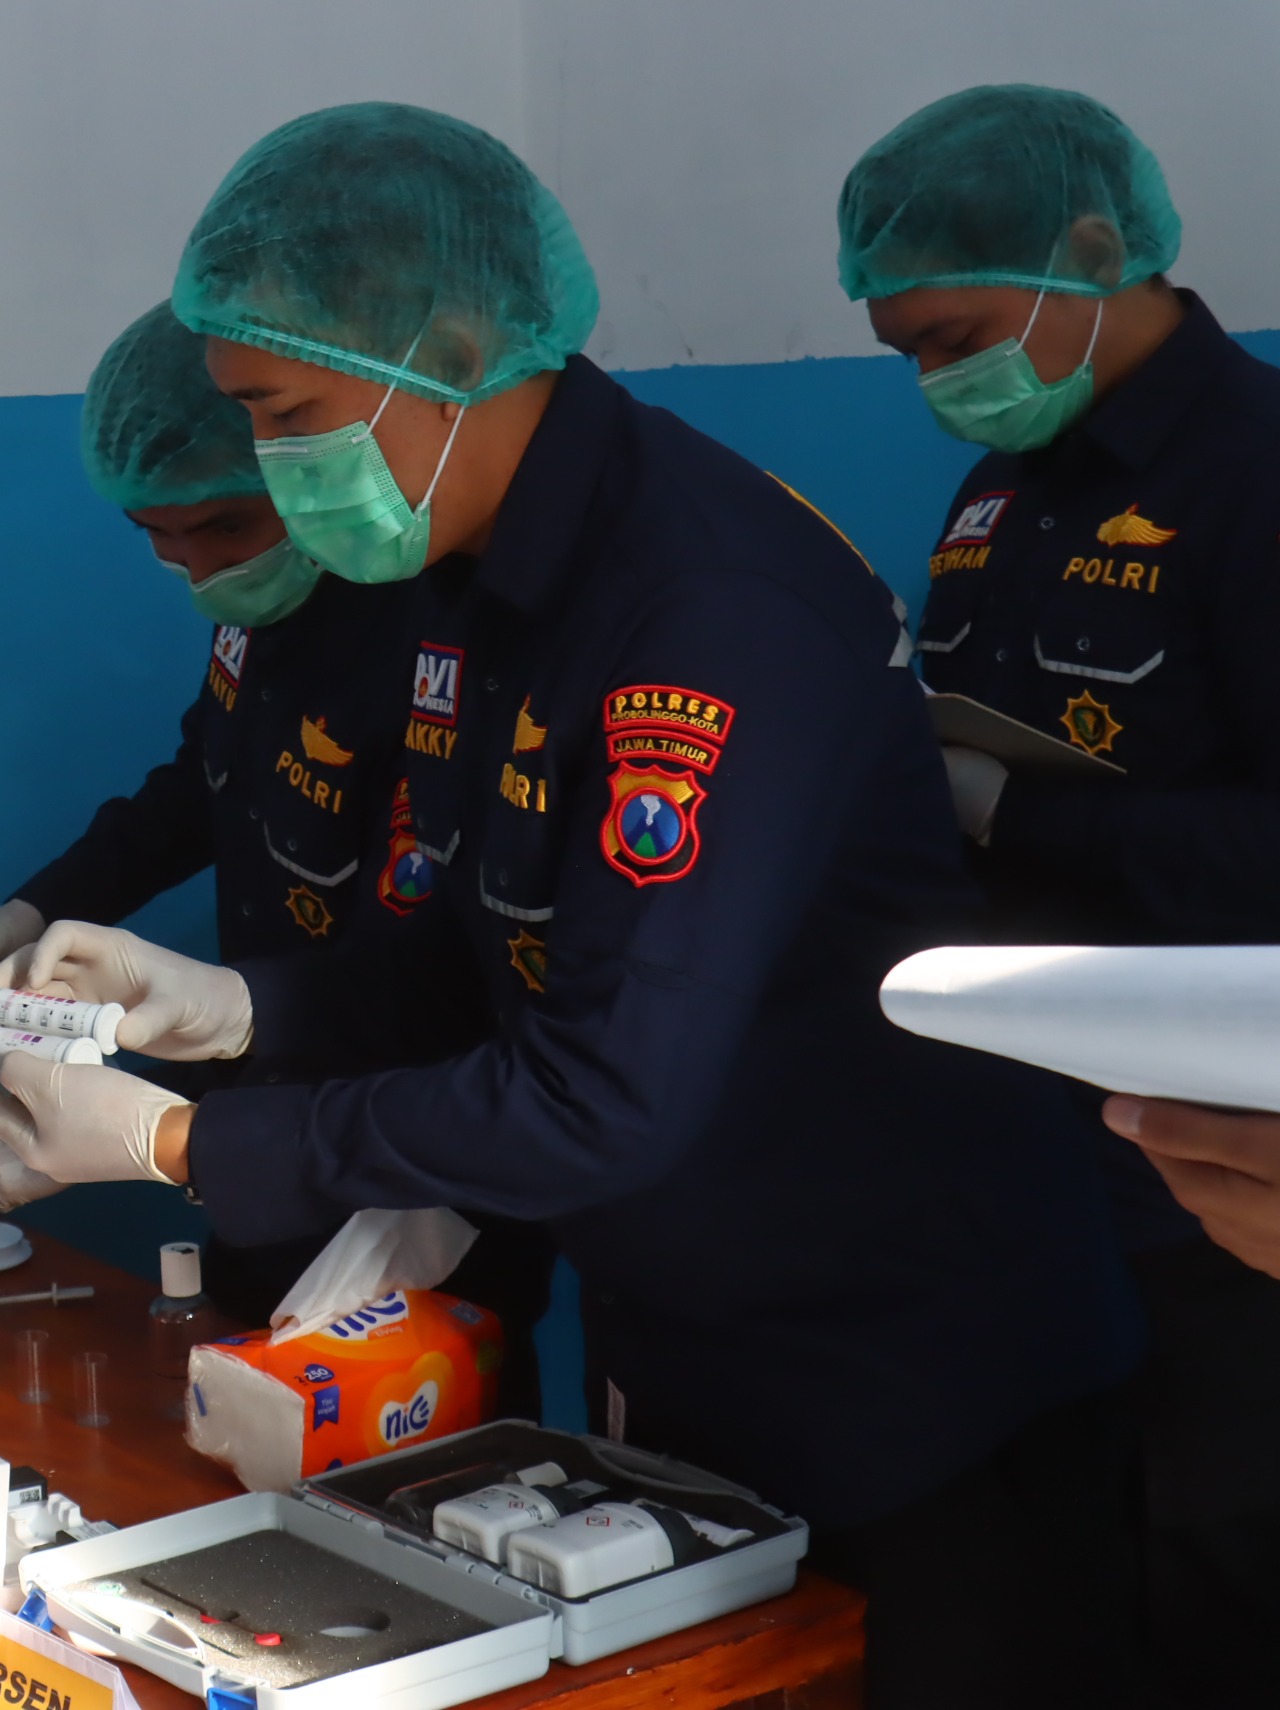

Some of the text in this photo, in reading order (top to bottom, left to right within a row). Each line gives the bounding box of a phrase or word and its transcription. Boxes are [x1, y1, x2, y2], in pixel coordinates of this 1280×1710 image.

[1062, 557, 1159, 593] POLRI
[615, 692, 719, 722] POLRES
[616, 738, 707, 764] JAWA TIMUR
[276, 750, 342, 814] POLRI
